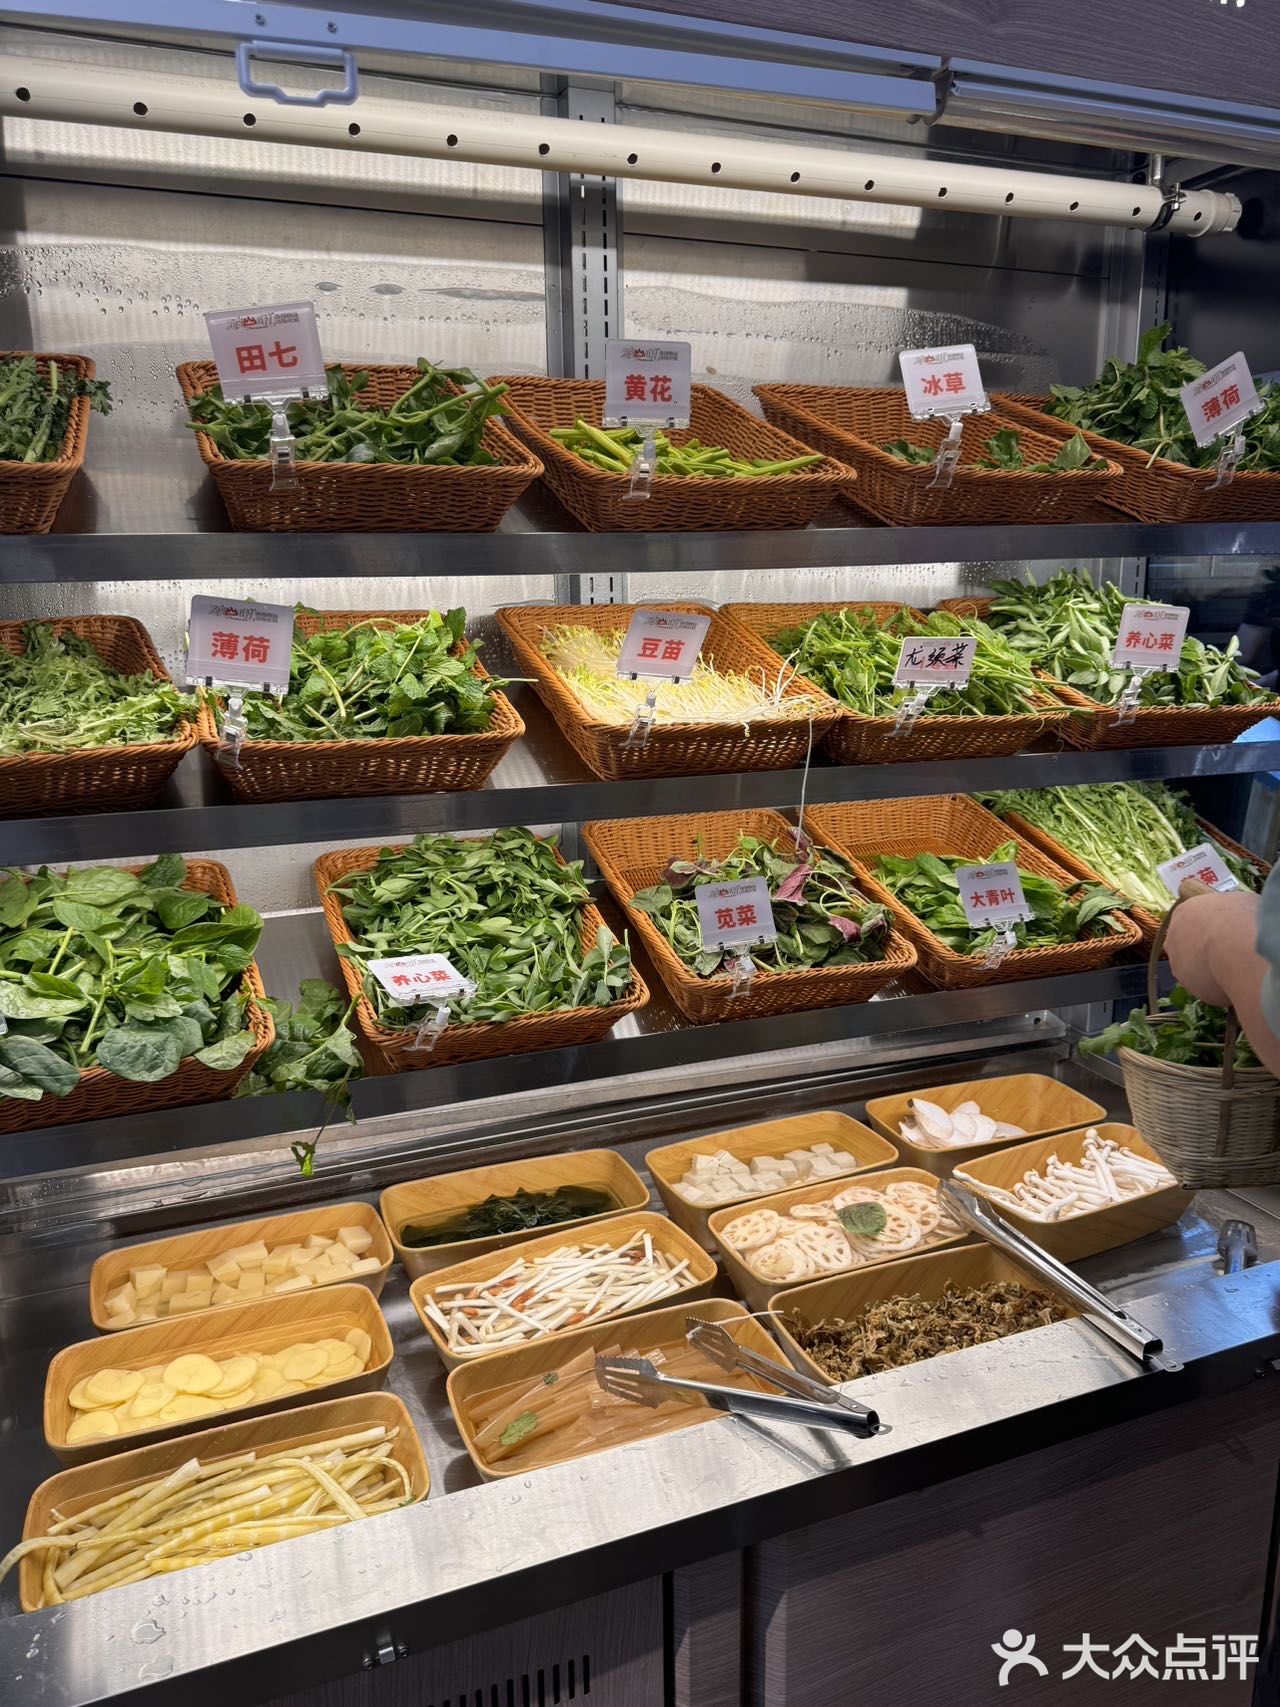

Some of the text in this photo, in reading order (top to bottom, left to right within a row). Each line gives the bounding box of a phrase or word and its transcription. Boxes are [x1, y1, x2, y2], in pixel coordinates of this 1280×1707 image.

[236, 341, 298, 373] 田七
[624, 374, 672, 402] 黄花
[921, 372, 966, 395] 冰草
[1201, 384, 1241, 422] 薄荷
[211, 631, 270, 663] 薄荷
[637, 638, 685, 660] 豆苗
[1126, 631, 1175, 650] 养心菜
[1181, 867, 1218, 885] 菊
[970, 888, 1015, 908] 大青叶
[715, 904, 757, 930] 苋菜
[391, 970, 452, 986] 养心菜
